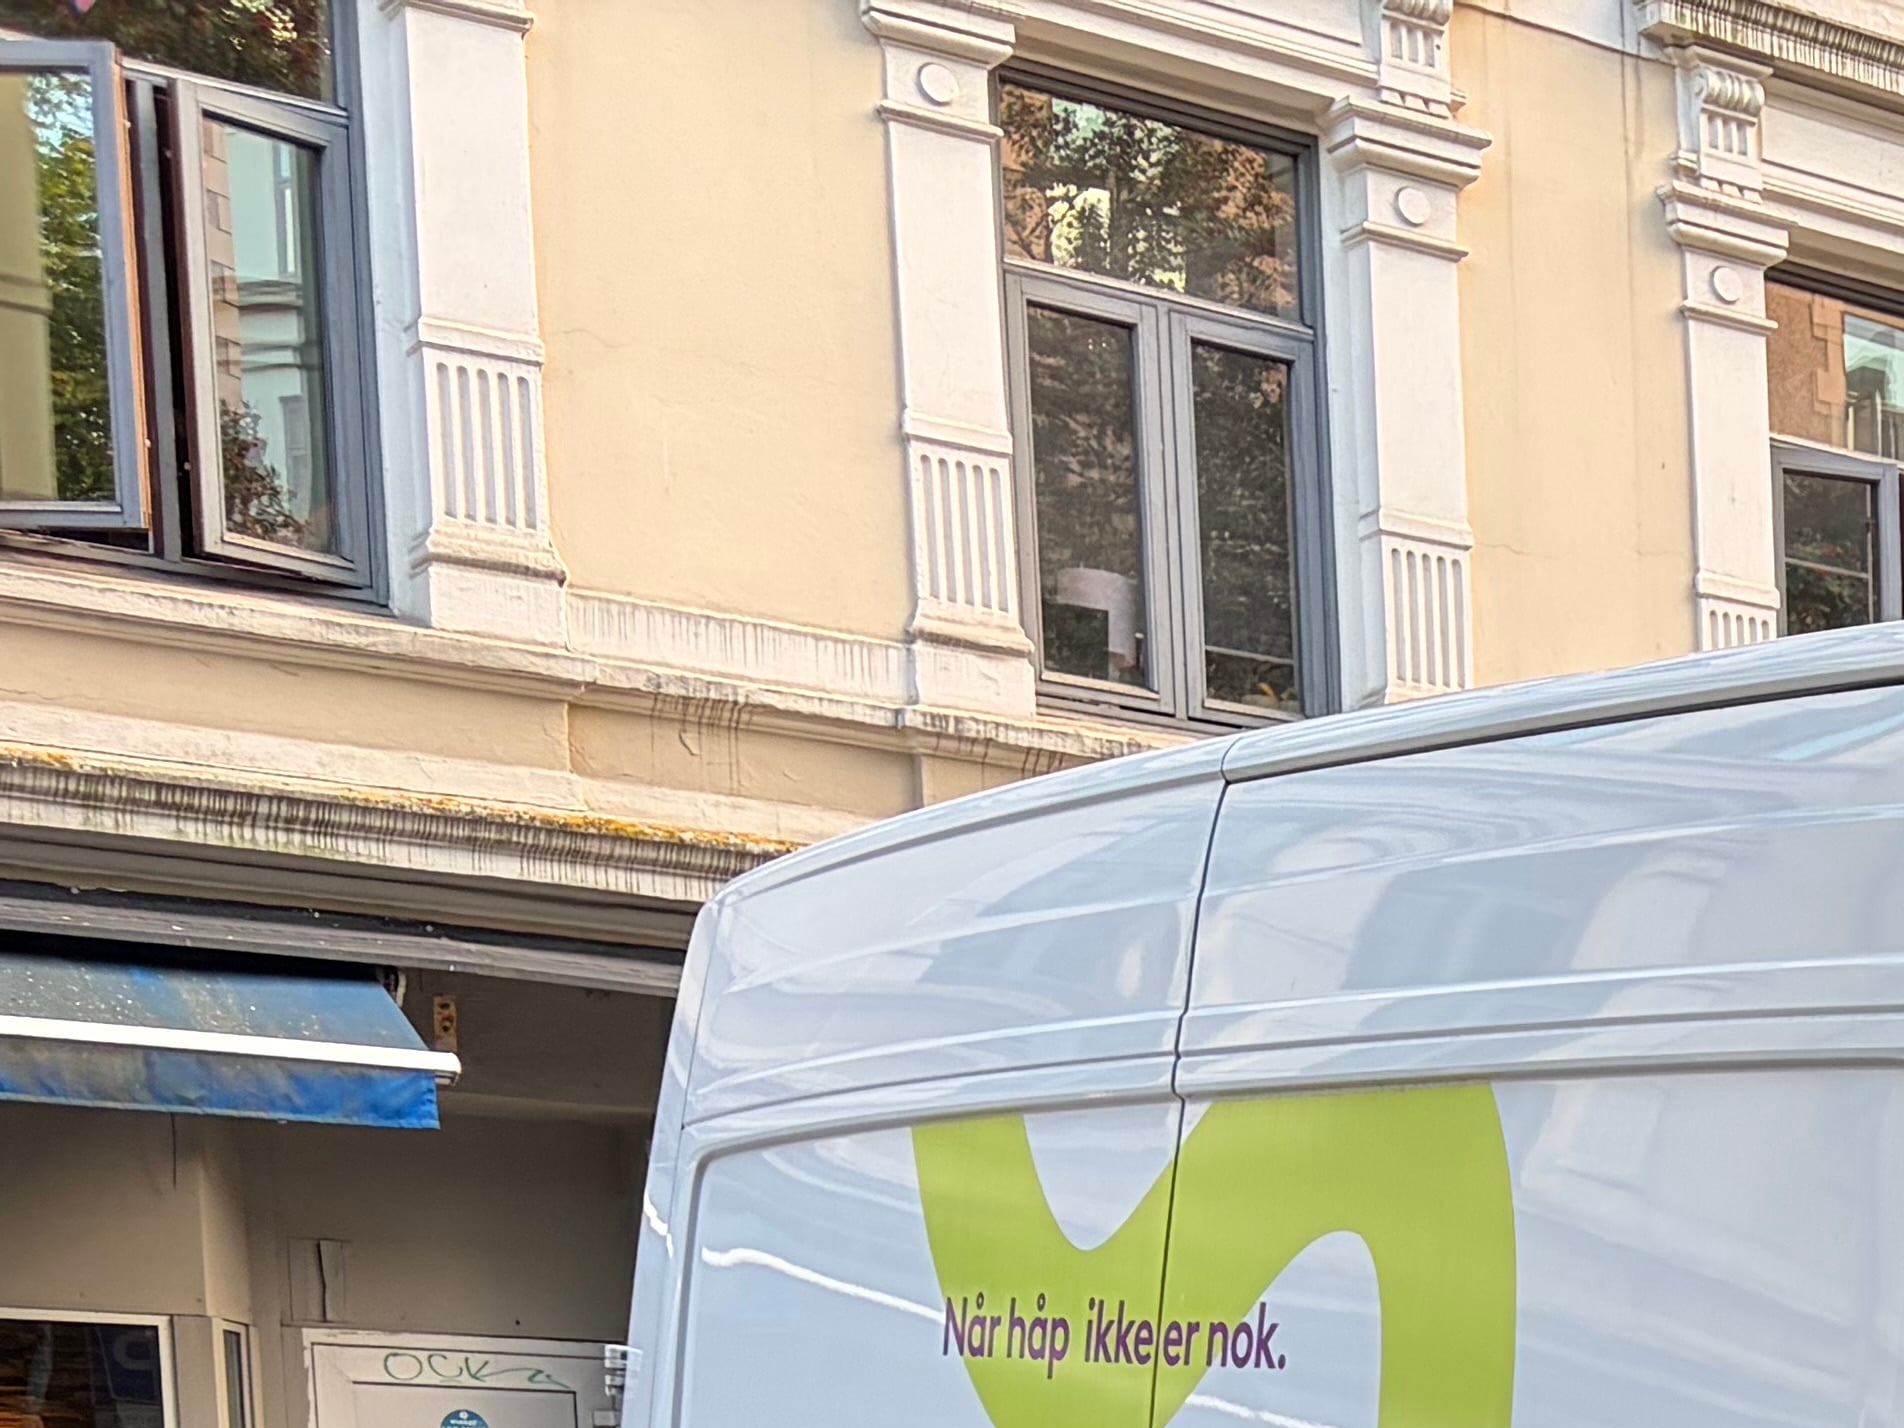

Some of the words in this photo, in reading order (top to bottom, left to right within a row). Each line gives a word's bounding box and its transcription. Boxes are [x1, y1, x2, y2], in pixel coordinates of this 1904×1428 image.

[943, 1292, 1001, 1357] Når
[1006, 1292, 1070, 1380] håp
[1084, 1297, 1154, 1365] ikke
[1163, 1320, 1200, 1367] er
[1206, 1302, 1286, 1369] nok.
